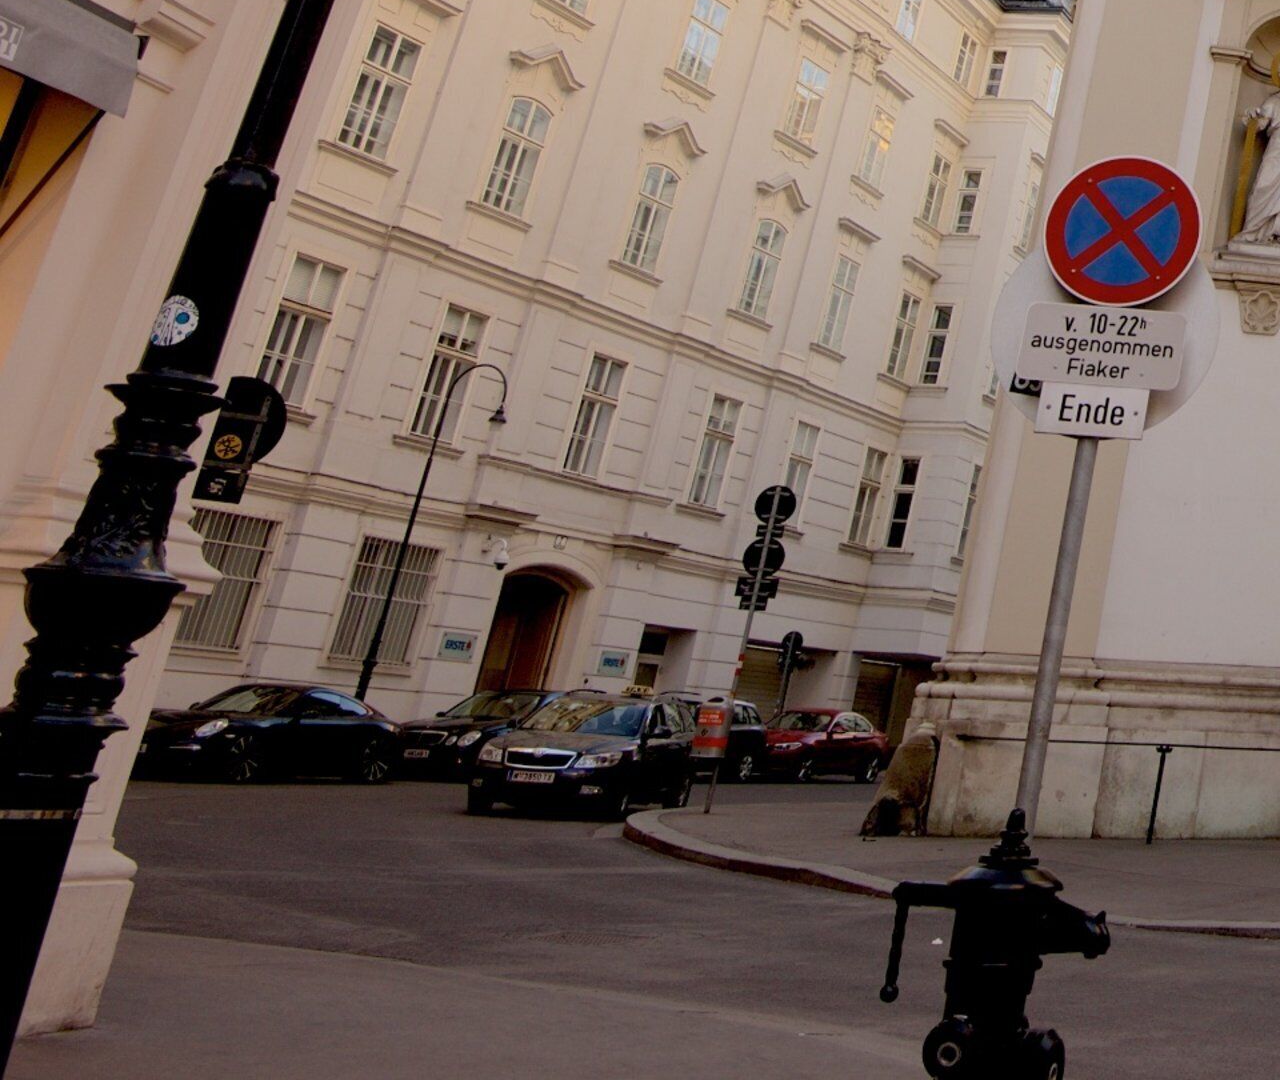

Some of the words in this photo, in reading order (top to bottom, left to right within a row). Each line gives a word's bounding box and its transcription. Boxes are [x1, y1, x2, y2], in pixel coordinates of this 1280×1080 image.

[1030, 335, 1174, 359] ausgenommen
[1065, 358, 1130, 380] Fiaker
[1057, 394, 1126, 427] Ende
